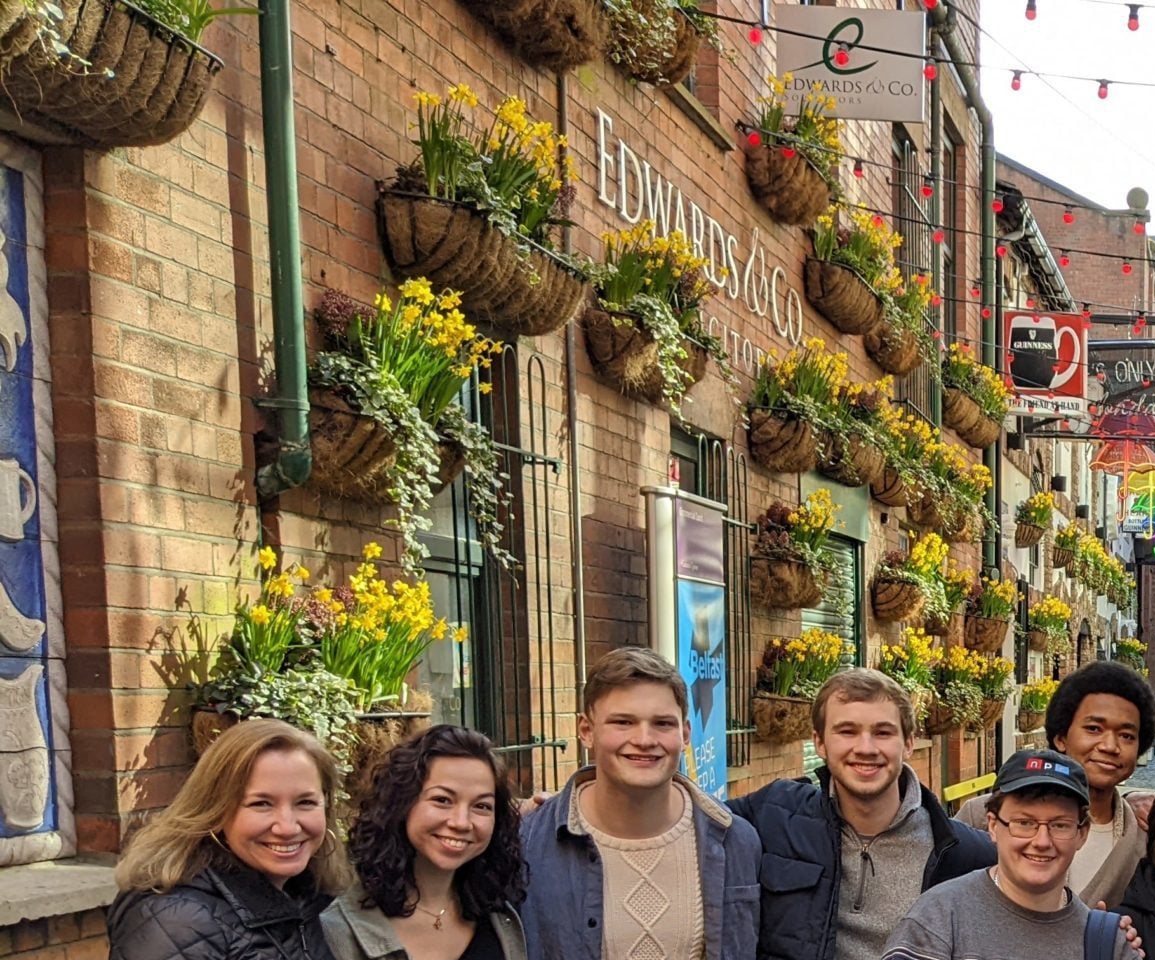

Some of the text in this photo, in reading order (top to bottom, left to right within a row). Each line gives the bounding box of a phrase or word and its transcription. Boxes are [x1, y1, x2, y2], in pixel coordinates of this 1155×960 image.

[784, 78, 862, 94] EDWARDS
[596, 107, 738, 300] EDWARDS
[744, 227, 768, 316] &
[1013, 341, 1053, 350] GUINNESS
[1023, 399, 1049, 409] FEND
[690, 650, 723, 680] Belfast
[684, 736, 716, 777] PLEASE
